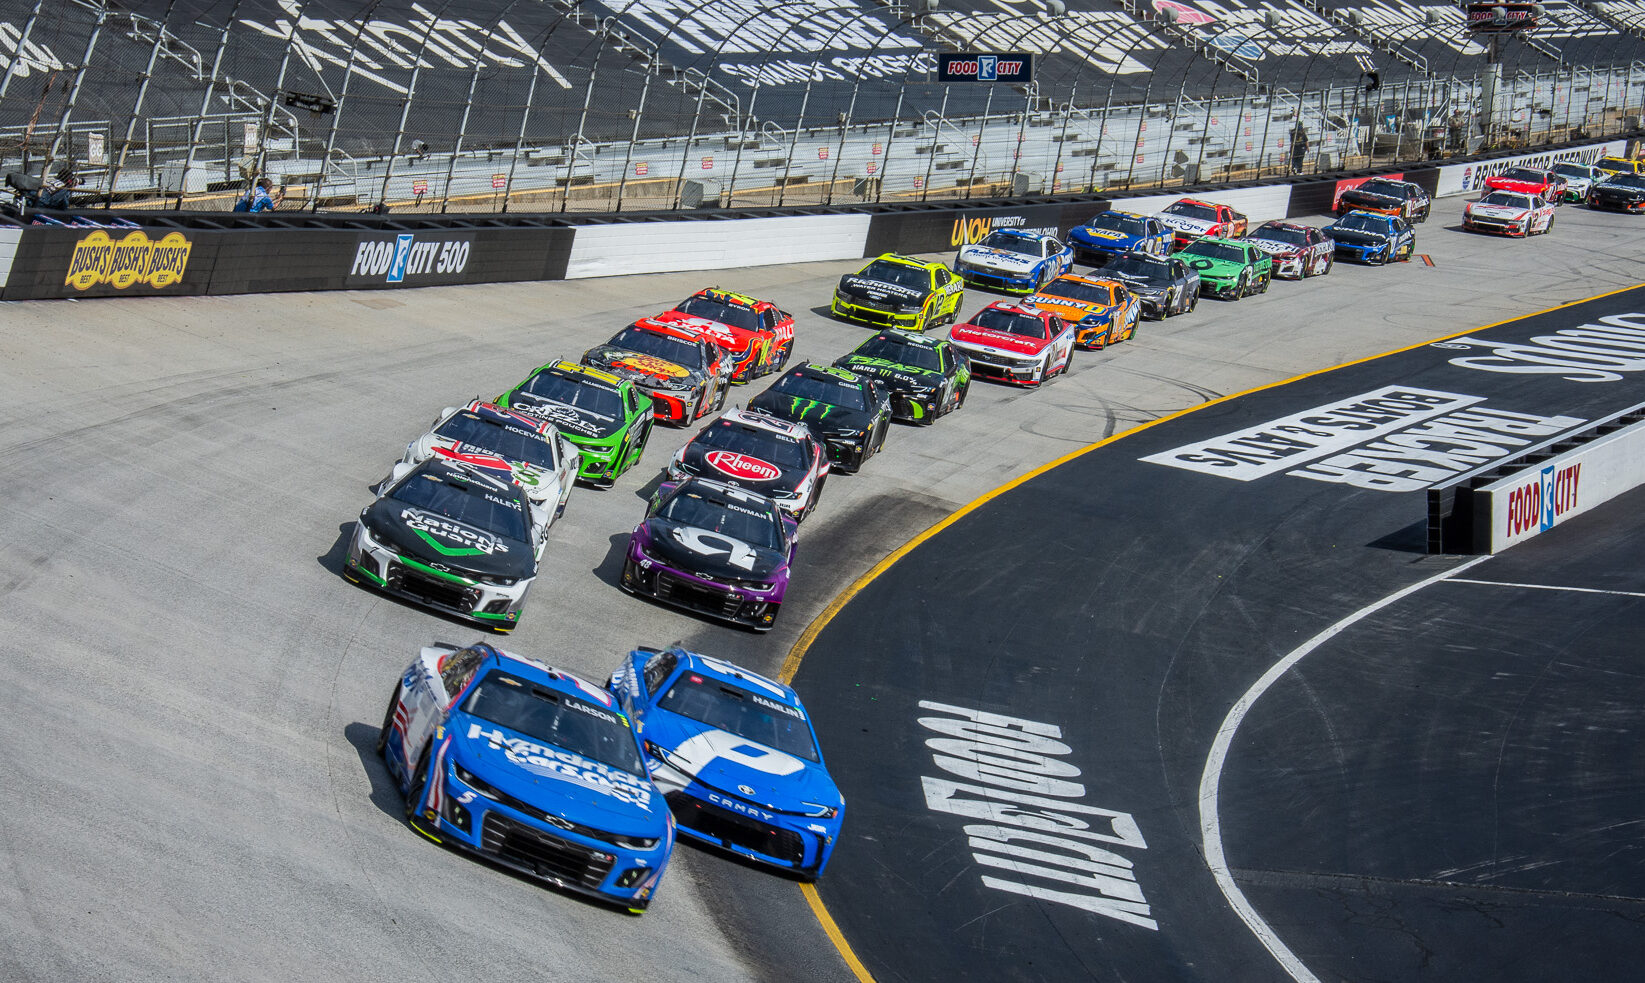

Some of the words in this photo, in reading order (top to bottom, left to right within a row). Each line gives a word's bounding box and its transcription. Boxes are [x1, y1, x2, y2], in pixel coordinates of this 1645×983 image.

[1470, 11, 1493, 21] FOOD
[1506, 10, 1528, 21] CITY
[597, 0, 923, 54] TENNESSEE
[239, 0, 572, 94] xfinity
[719, 59, 845, 87] SOUNDS
[831, 52, 938, 80] PERFECT
[948, 61, 978, 75] FOOD
[997, 61, 1022, 75] CITY
[1472, 160, 1514, 190] BRISTOL
[1553, 147, 1600, 166] SPEEDWAY
[951, 213, 992, 246] UNOH
[992, 216, 1021, 228] UNIVERSITY
[1165, 218, 1207, 233] Kroger
[1089, 228, 1122, 239] NAPA
[69, 245, 111, 277] BUSH'S
[108, 245, 150, 277] BUSH'S
[147, 246, 188, 276] BUSH'S
[350, 240, 395, 276] FOOD
[406, 241, 441, 275] CITY
[436, 241, 470, 274] 500
[79, 274, 93, 284] BEST
[118, 273, 131, 283] BEST
[846, 277, 923, 299] Richmond
[852, 283, 876, 292] WATER
[727, 302, 751, 312] BYRON
[934, 294, 945, 317] 12
[666, 335, 698, 348] BRISCOE
[667, 319, 736, 345] AXALTA
[958, 328, 1037, 349] Motorcraft
[907, 341, 934, 351] REDDICK
[610, 360, 671, 382] CLUB
[846, 355, 943, 376] BEAST
[852, 364, 877, 373] HARD
[838, 381, 860, 390] GIBBS
[1298, 390, 1460, 432] BOATS
[505, 424, 547, 443] HOCEVAR
[555, 418, 599, 438] POUCHES
[775, 433, 796, 444] BELL
[1270, 424, 1336, 438] &
[1285, 406, 1588, 492] TRACKER
[712, 451, 777, 479] Rheem
[446, 471, 498, 493] NationsGuard
[485, 493, 519, 511] HALEY
[1507, 481, 1540, 538] FOOD
[1554, 462, 1582, 516] CITY
[727, 503, 767, 520] BOWMAN
[401, 507, 510, 553] Nations
[405, 518, 494, 555] Guard
[369, 546, 380, 554] 7
[639, 558, 652, 569] 48
[564, 698, 618, 725] LARSON
[752, 695, 800, 718] HAMLIN
[466, 722, 652, 793] Hendrick
[916, 699, 1087, 798] FOOD
[504, 748, 652, 810] Cars.com
[457, 790, 478, 804] 5
[708, 793, 774, 821] CAMRY
[962, 824, 1159, 931] CITY
